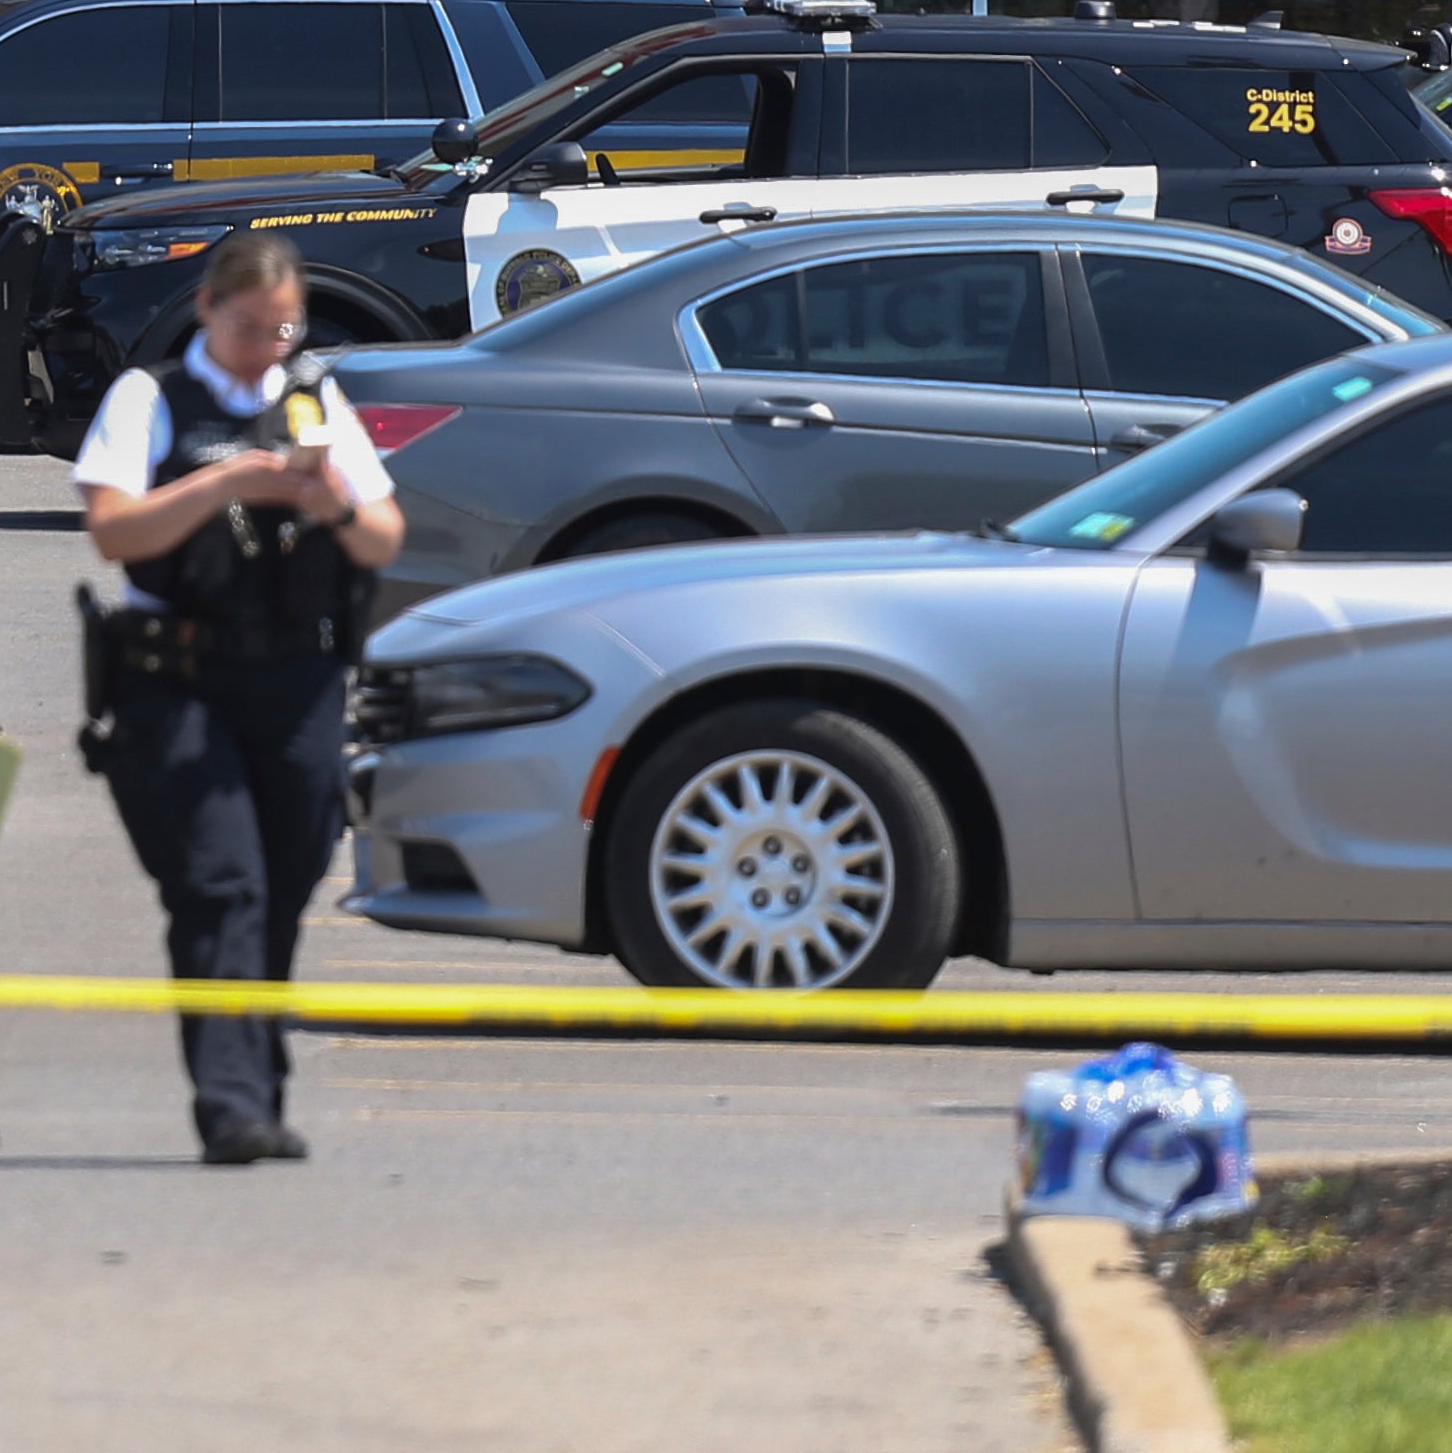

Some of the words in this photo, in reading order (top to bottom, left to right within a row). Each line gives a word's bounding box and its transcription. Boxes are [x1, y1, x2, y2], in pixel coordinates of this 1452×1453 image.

[1246, 88, 1314, 103] C-District
[1248, 102, 1315, 135] 245
[250, 214, 313, 229] SERVING
[316, 211, 345, 223] THE
[346, 208, 438, 222] COMMUNITY
